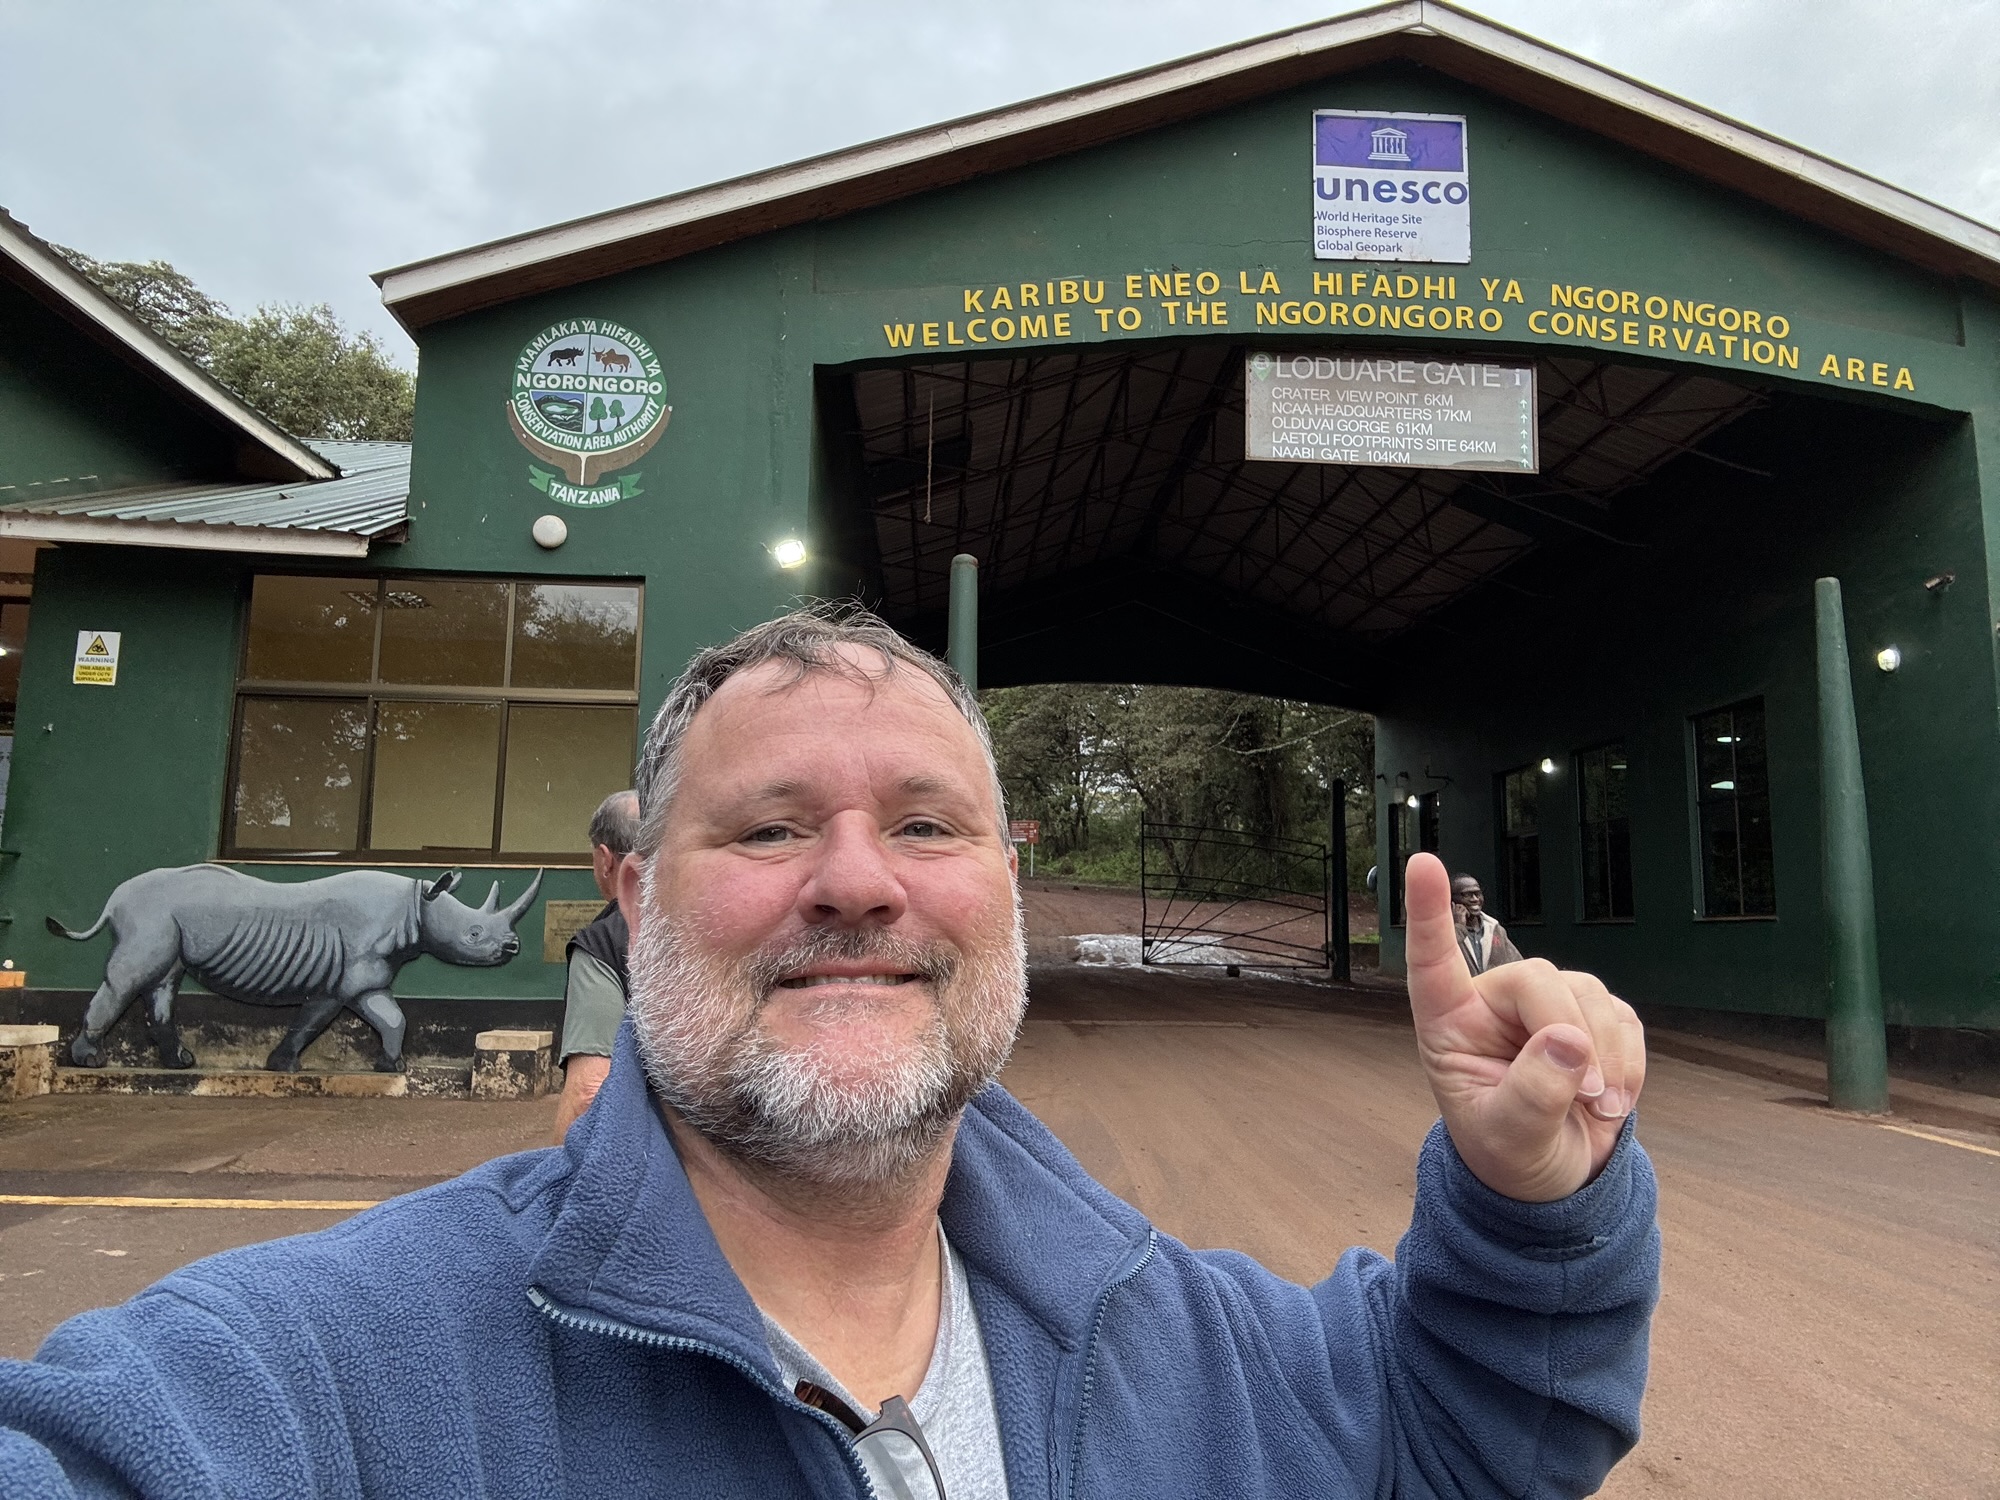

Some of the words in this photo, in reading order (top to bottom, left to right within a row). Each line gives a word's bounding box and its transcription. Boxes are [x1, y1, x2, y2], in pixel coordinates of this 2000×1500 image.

[1316, 177, 1468, 205] unesco
[1316, 211, 1350, 222] World
[1352, 213, 1399, 226] Heritage
[1401, 214, 1422, 225] Site
[1317, 226, 1372, 238] Biosphere
[1374, 228, 1418, 239] Reserve
[1317, 240, 1353, 252] Global
[1355, 242, 1403, 254] Geopark
[964, 280, 1104, 313] KARIBU
[1126, 271, 1220, 298] ENEO
[1240, 271, 1281, 295] LA
[1313, 271, 1456, 300] HIFADHI
[1480, 277, 1524, 304] YA
[1551, 283, 1790, 339] NGORONGORO
[517, 321, 580, 372] MAMLAKA
[582, 320, 597, 334] YA
[600, 322, 653, 360] HIFADHI
[645, 359, 662, 378] YA
[883, 313, 1071, 348] WELCOME
[1094, 306, 1142, 332] TO
[1161, 301, 1228, 325] THE
[1256, 301, 1503, 332] NGORONGORO
[1528, 310, 1799, 369] CONSERVATION
[1820, 353, 1914, 391] AREA
[1276, 355, 1416, 384] LODUARE
[1422, 361, 1501, 388] GATE
[516, 372, 663, 395] NGORONGORO
[1272, 387, 1330, 402] CRATER
[1336, 389, 1373, 403] VIEW
[1376, 391, 1418, 404] POINT
[1424, 393, 1454, 406] 6KM
[515, 391, 582, 449] CONSERVATION
[584, 436, 612, 450] AREA
[613, 397, 660, 444] AUTHORITY
[1272, 402, 1312, 416] NCAA
[1314, 404, 1432, 421] HEADQUARTERS
[1436, 409, 1472, 422] 17KM
[1272, 416, 1334, 431] OLDUVAI
[1336, 419, 1390, 434] GORGE
[1395, 422, 1432, 436] 61KM
[1272, 432, 1330, 446] LAETOLI
[1333, 434, 1424, 450] FOOTPRINTS
[1426, 438, 1456, 452] SITE
[1460, 440, 1496, 454] 64KM
[1272, 446, 1314, 460] NAABI
[1320, 448, 1360, 462] GATE
[1366, 450, 1410, 464] 104KM
[550, 482, 620, 505] TANZANIA
